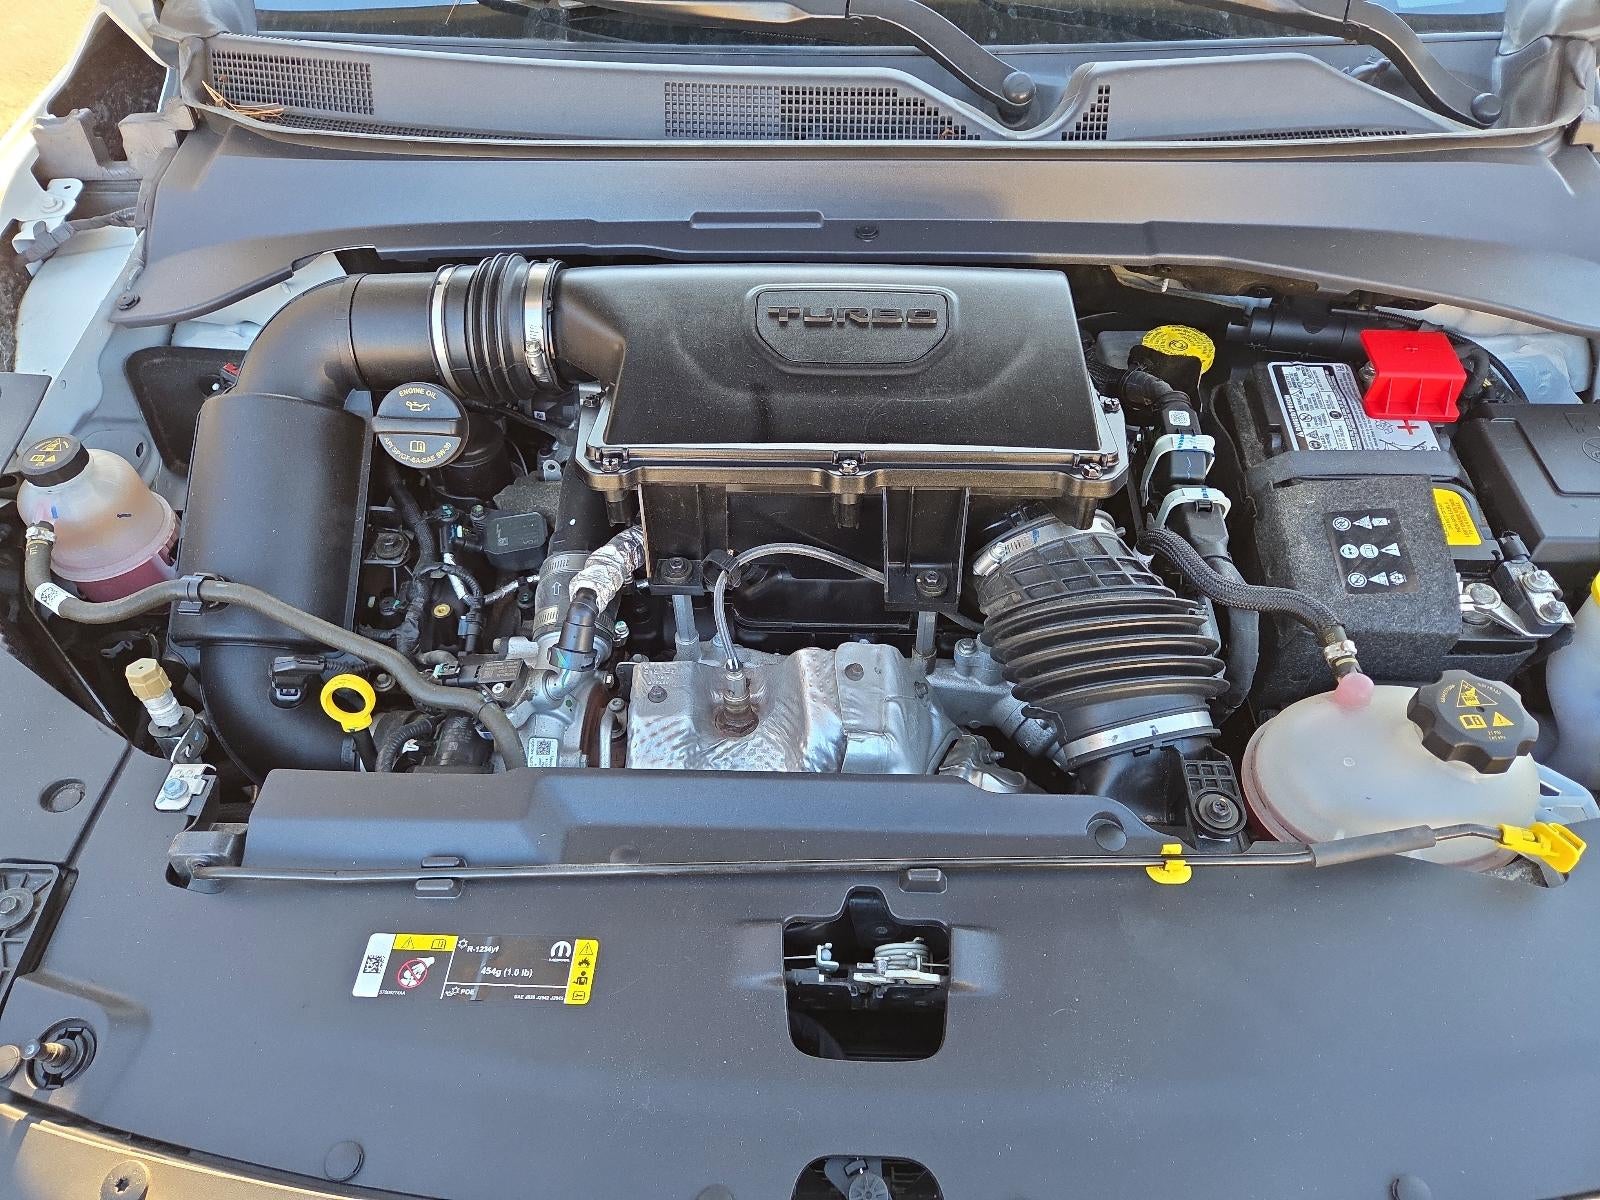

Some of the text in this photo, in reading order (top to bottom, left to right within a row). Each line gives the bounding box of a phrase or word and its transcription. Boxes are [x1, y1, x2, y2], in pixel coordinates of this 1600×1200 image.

[767, 306, 938, 326] TURBO
[399, 387, 437, 400] ENGINE OIL
[481, 966, 534, 979] 454g (1.0 lb)
